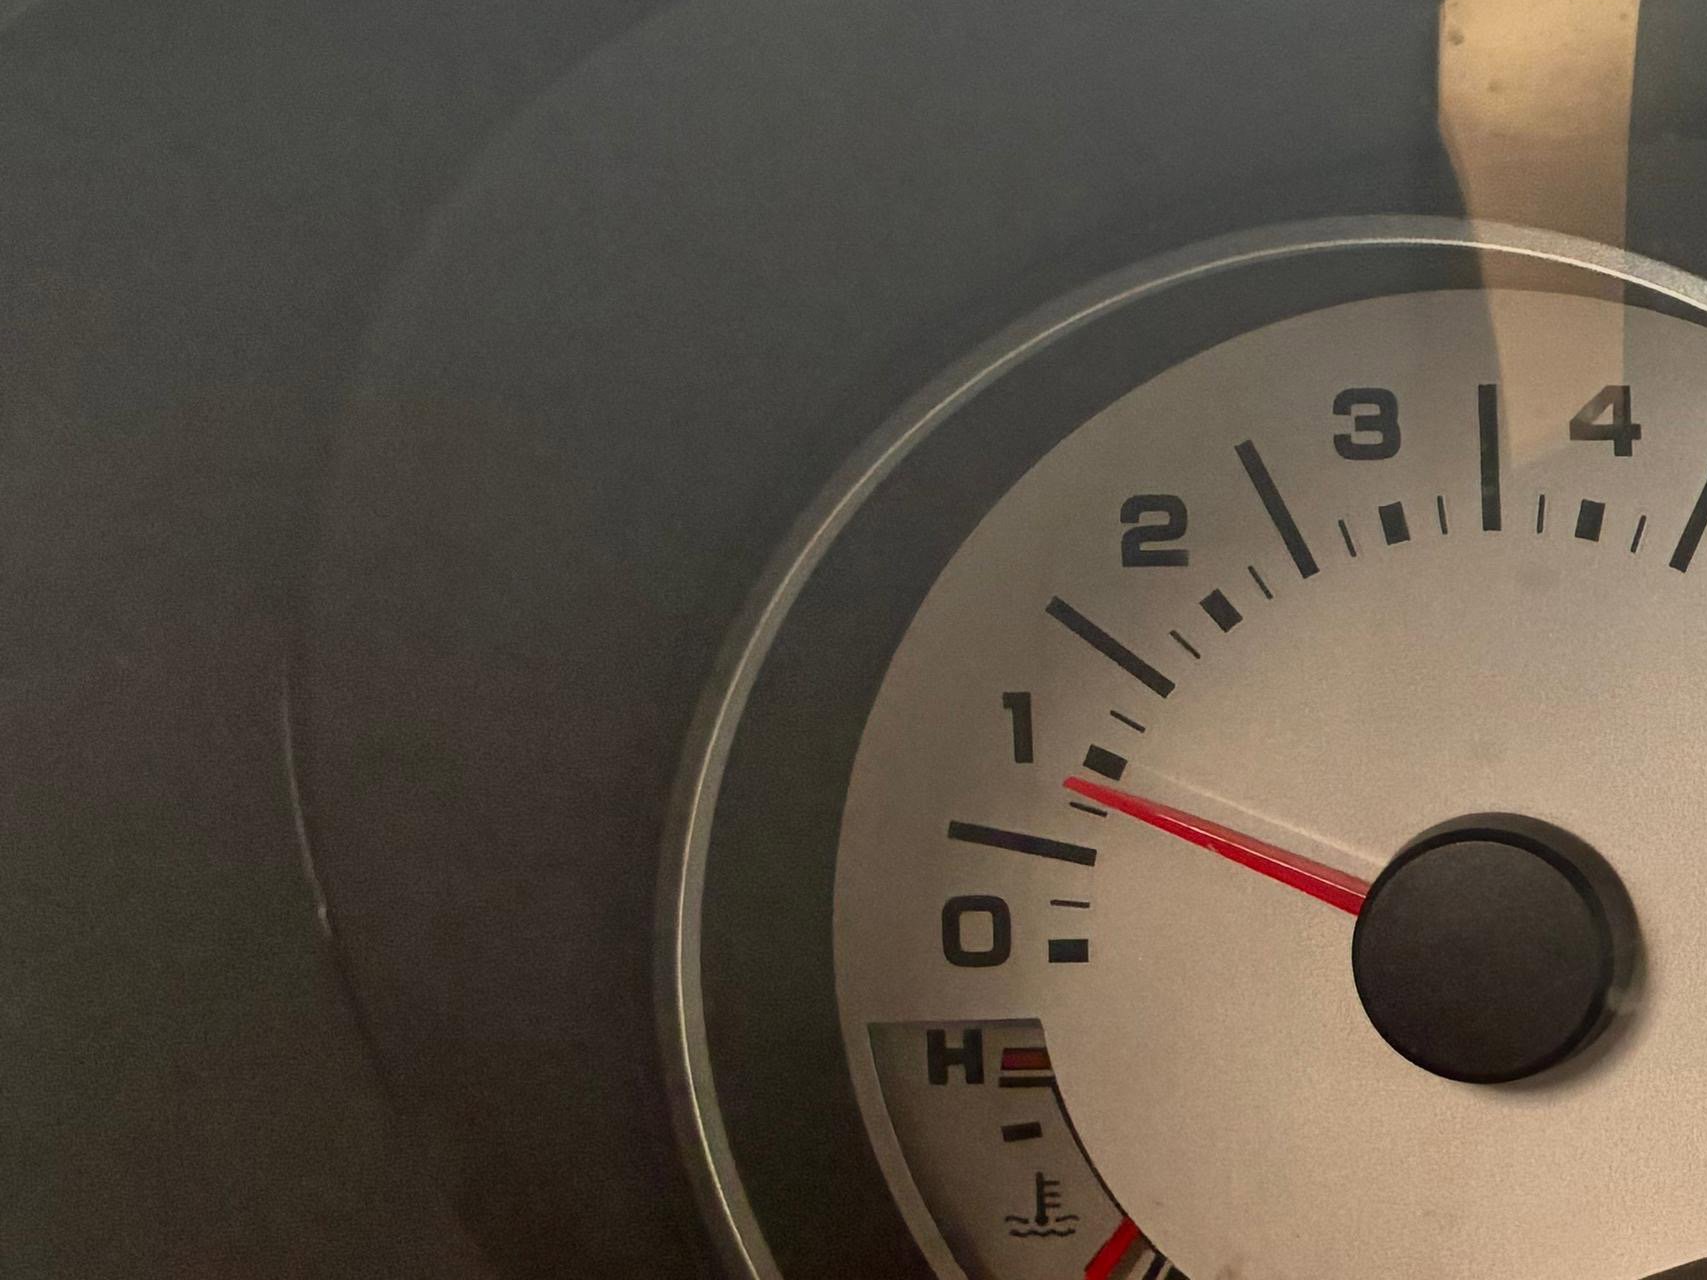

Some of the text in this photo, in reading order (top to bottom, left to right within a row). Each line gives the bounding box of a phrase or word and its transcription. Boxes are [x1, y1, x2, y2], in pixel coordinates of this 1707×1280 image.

[1333, 388, 1400, 460] 3
[1570, 385, 1641, 457] 4
[1120, 495, 1188, 567] 2
[1002, 692, 1033, 763] 1
[941, 895, 1011, 968] 0
[926, 1028, 984, 1085] H
